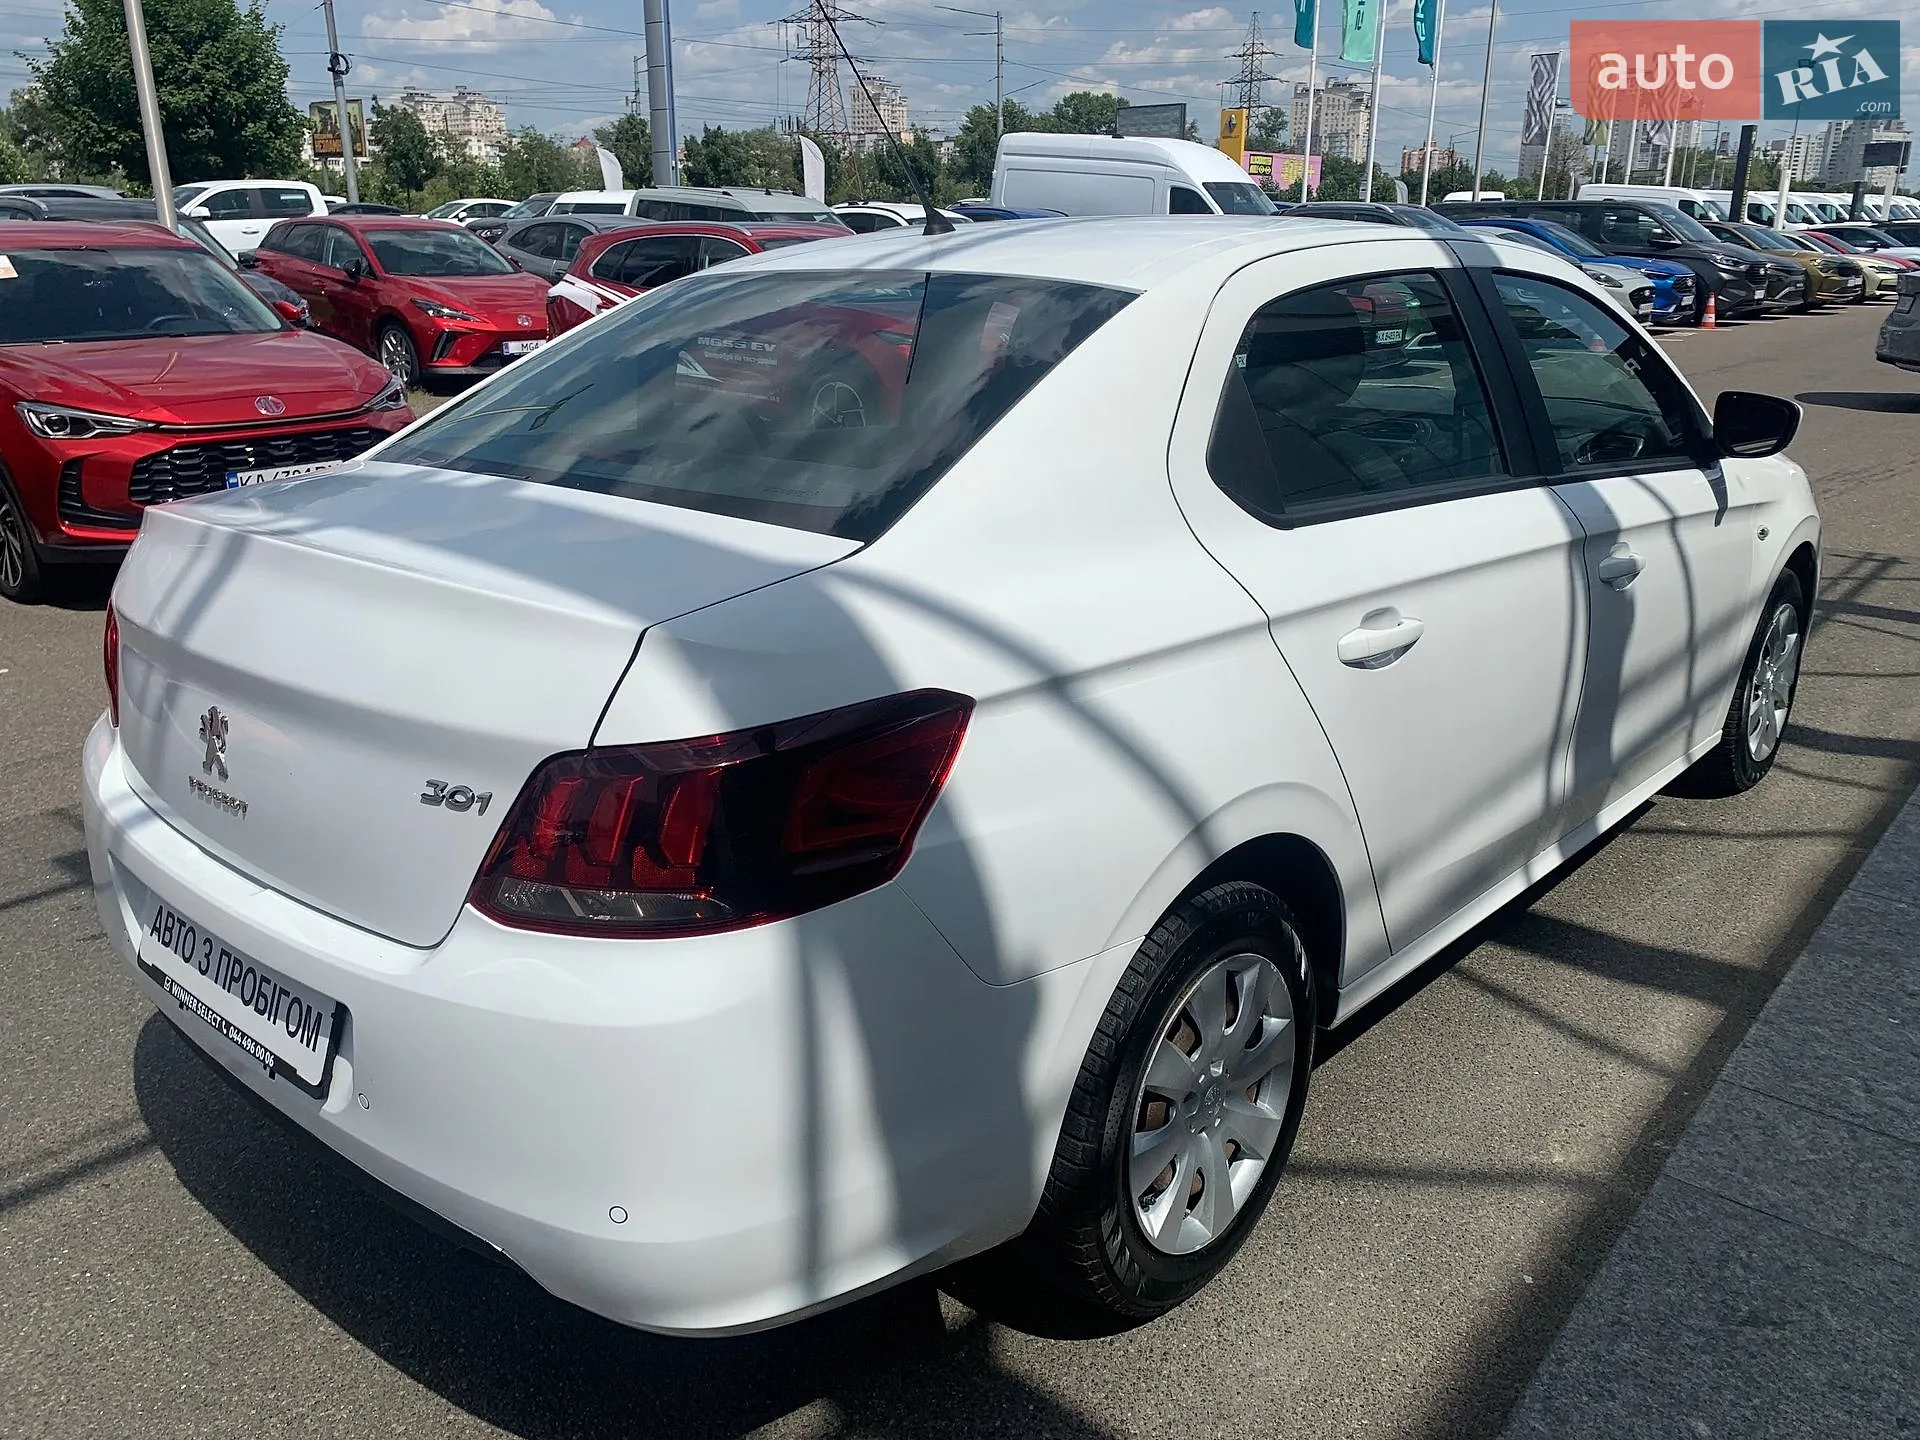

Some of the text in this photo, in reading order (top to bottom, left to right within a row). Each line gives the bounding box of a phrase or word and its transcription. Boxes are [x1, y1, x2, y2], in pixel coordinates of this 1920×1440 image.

[189, 776, 248, 819] PEUGEOT
[420, 779, 493, 816] 301
[150, 904, 197, 964] АВТО
[214, 947, 323, 1053] ПРОБІГОМ
[171, 982, 275, 1067] WINNER SELECT 044 496 00 06
